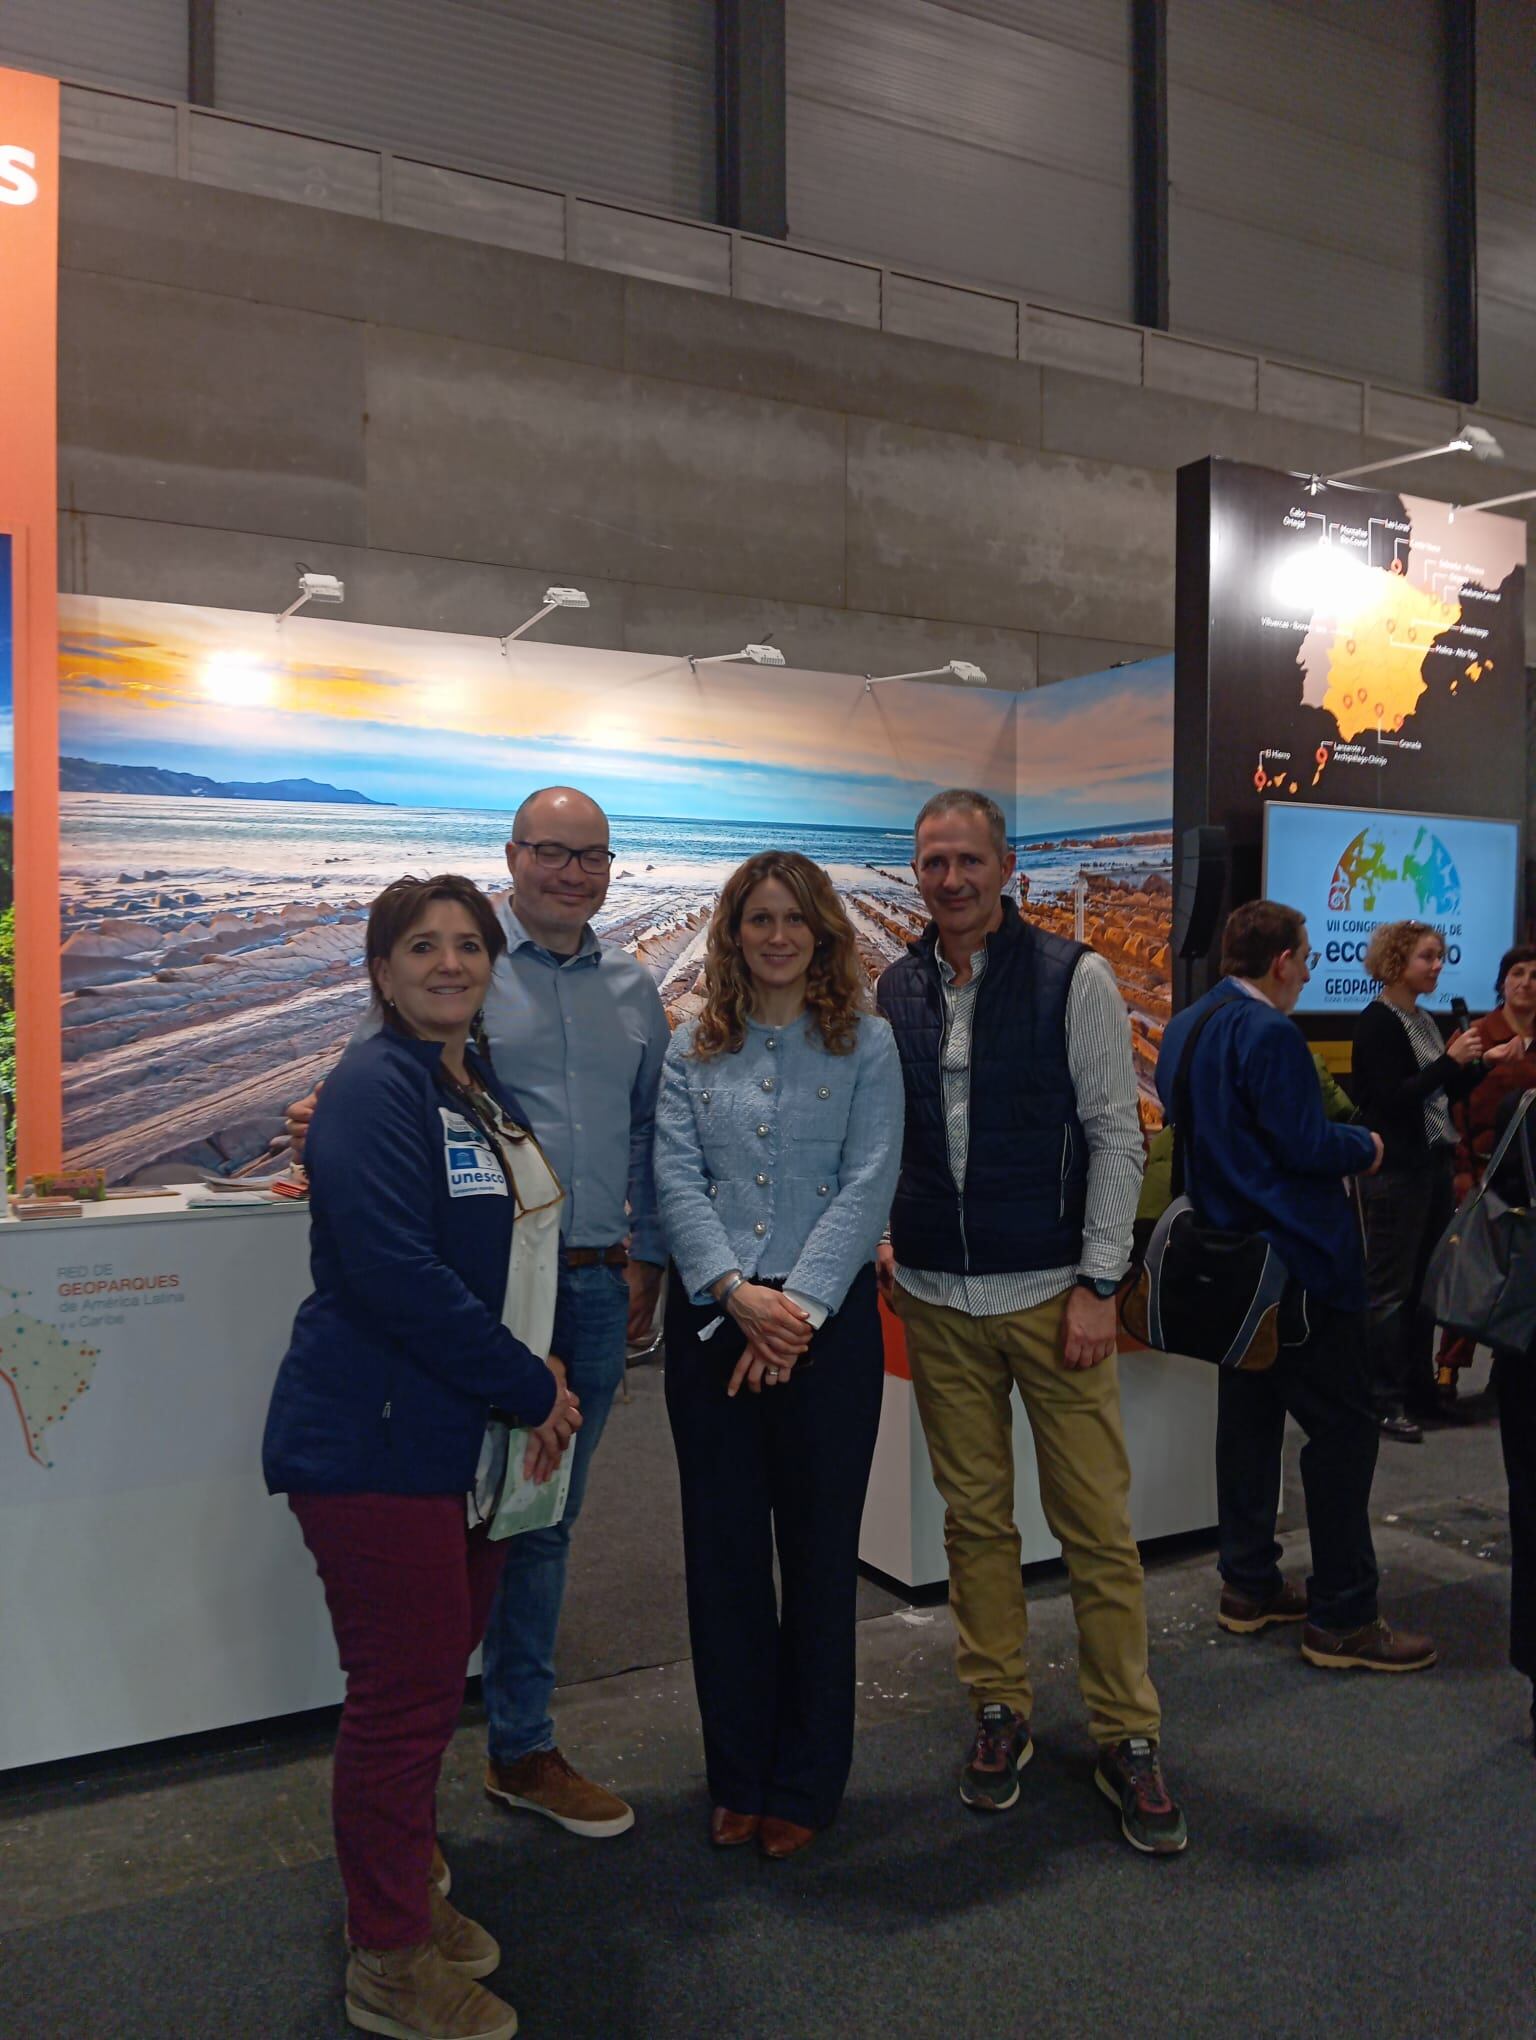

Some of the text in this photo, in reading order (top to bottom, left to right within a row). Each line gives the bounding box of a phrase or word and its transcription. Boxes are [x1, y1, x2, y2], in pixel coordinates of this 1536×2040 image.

[1327, 919, 1340, 932] VII
[1449, 924, 1463, 937] DE
[451, 1172, 505, 1185] unesco
[56, 1263, 113, 1279] RED DE
[58, 1274, 180, 1297] GEOPARQUES
[59, 1291, 185, 1313] de América Latina
[79, 1313, 125, 1328] Caribe
